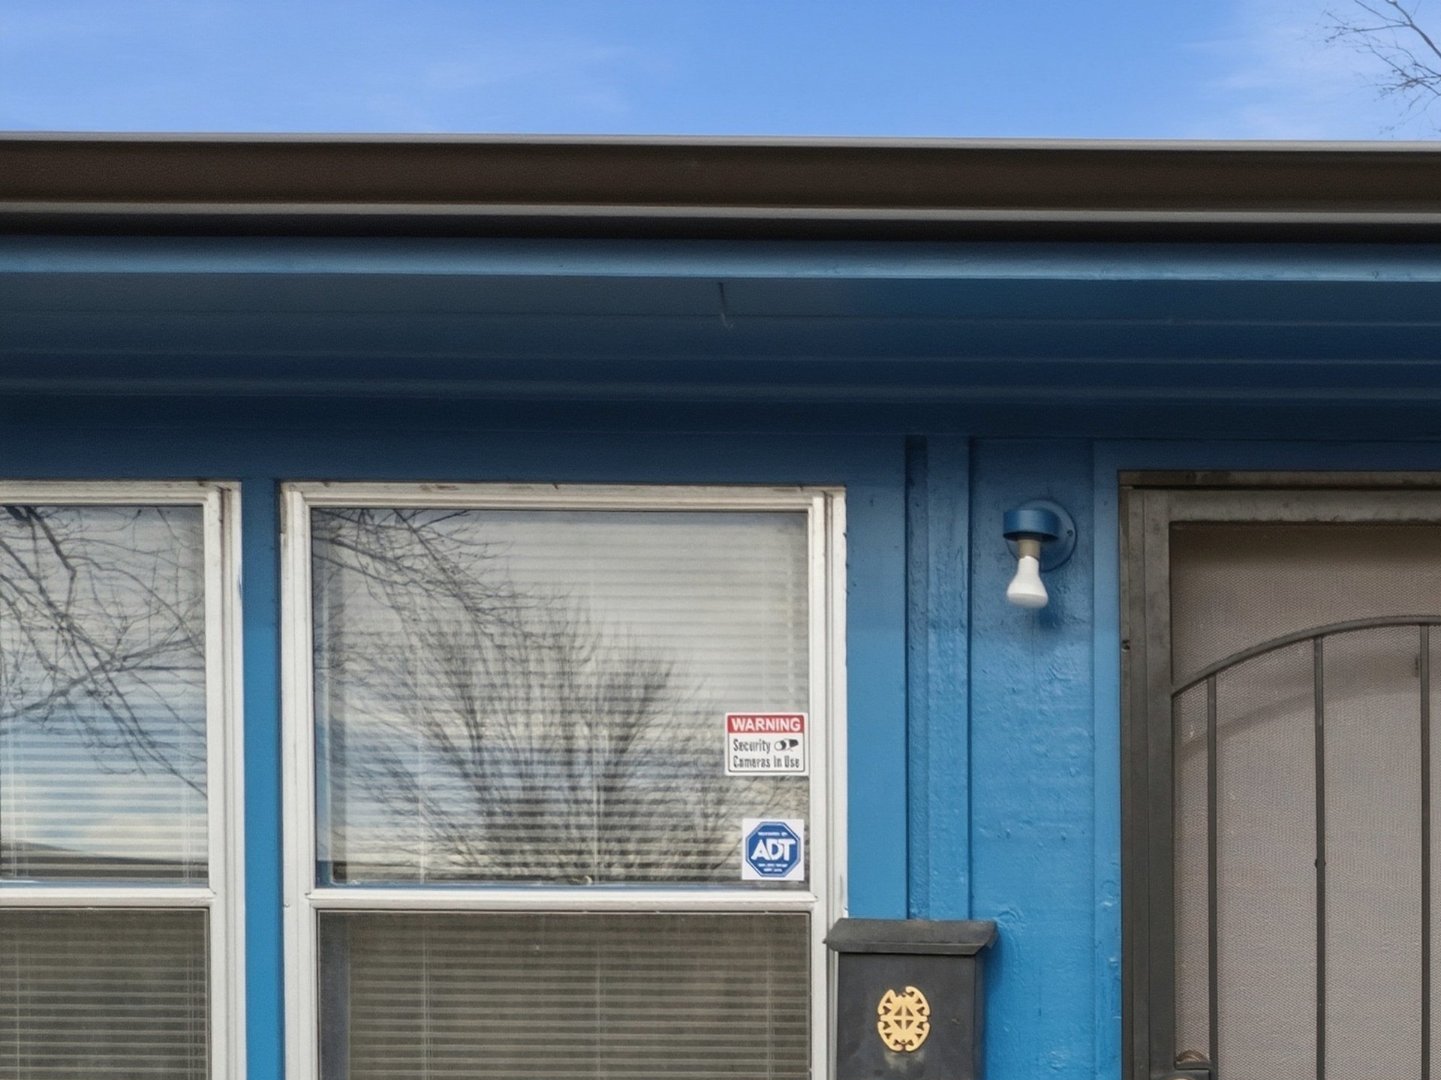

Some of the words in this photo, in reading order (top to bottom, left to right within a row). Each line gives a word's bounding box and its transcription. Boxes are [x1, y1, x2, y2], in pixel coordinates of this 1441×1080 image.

[730, 717, 801, 732] WARNING
[733, 738, 771, 754] Security
[733, 755, 771, 768] Cameras
[784, 755, 800, 768] Use
[750, 838, 796, 861] ADT
